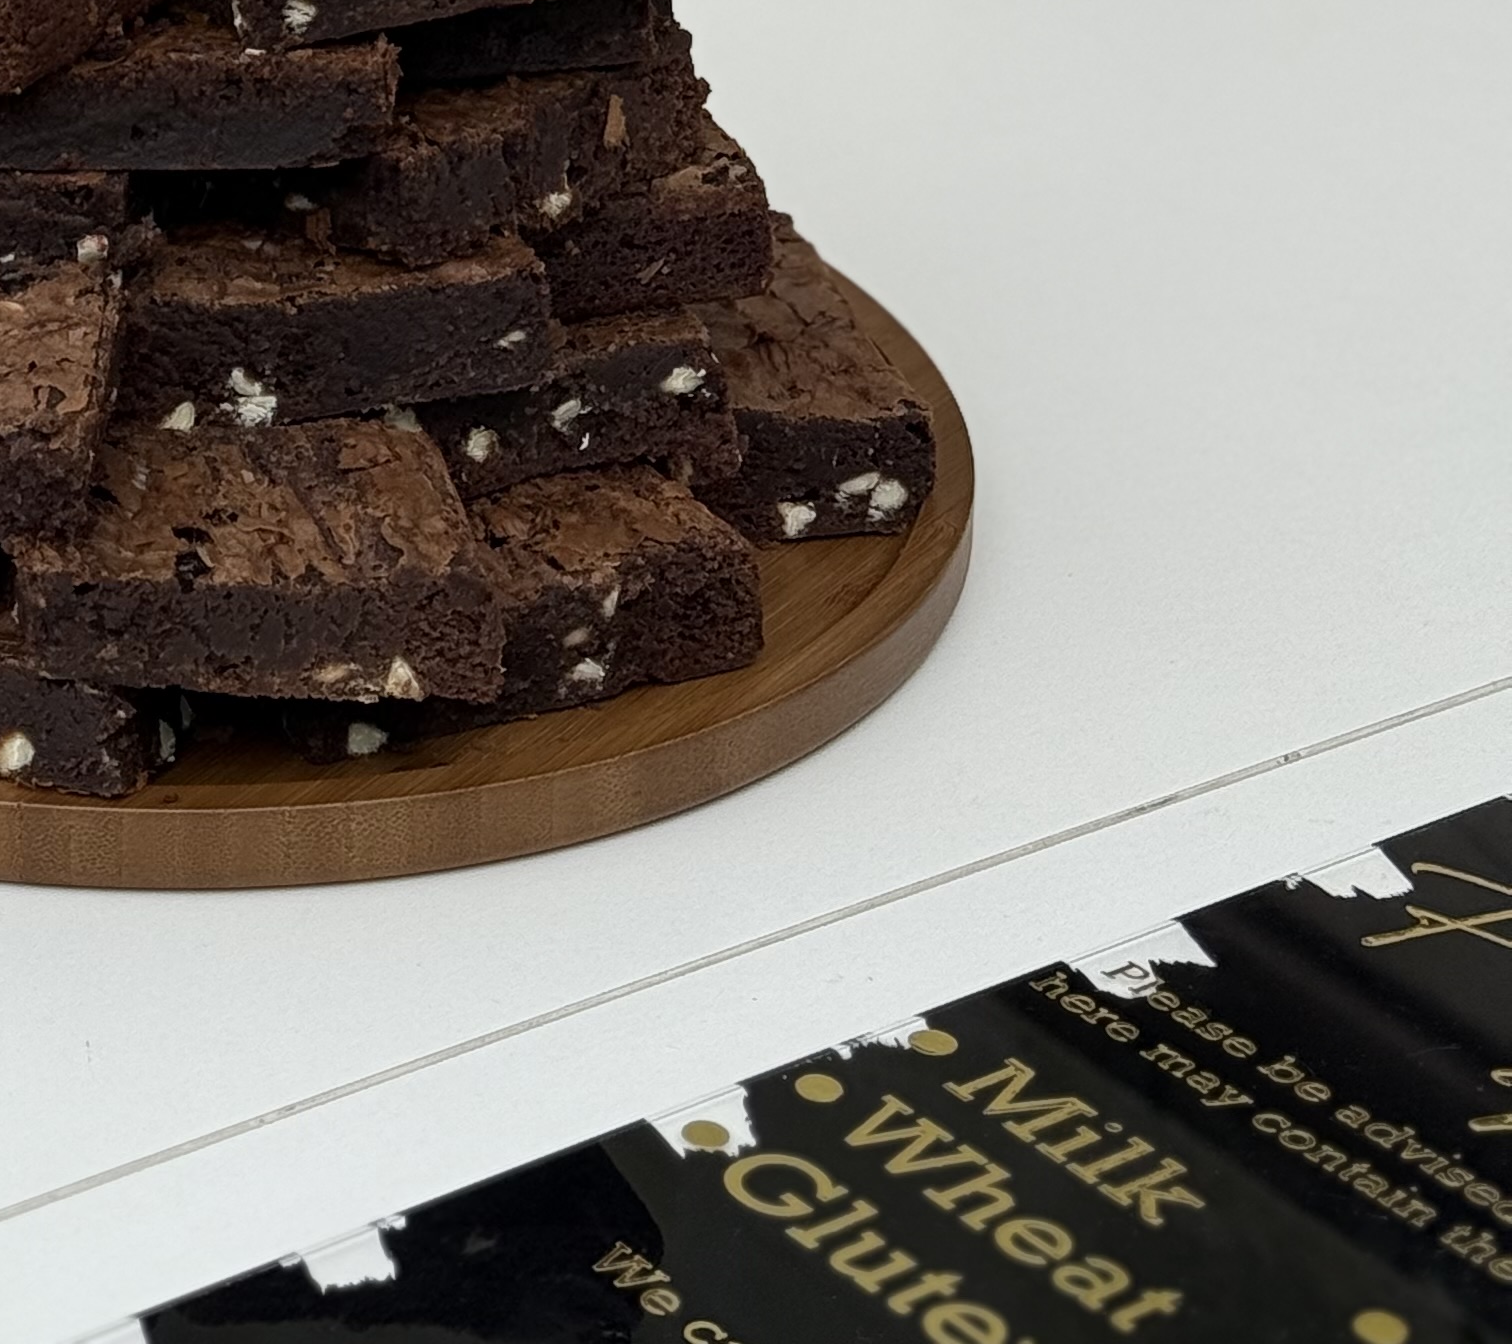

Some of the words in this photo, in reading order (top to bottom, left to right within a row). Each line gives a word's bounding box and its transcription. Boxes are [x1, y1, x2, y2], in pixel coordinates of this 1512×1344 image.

[1029, 971, 1140, 1043] here
[1139, 1043, 1254, 1106] may
[1252, 1112, 1437, 1228] contain
[1101, 960, 1258, 1059] Please
[1257, 1057, 1331, 1103] be
[844, 1094, 1182, 1333] Wheat
[942, 1057, 1206, 1226] Milk
[592, 1241, 681, 1316] We
[723, 1153, 1038, 1344] Glute
